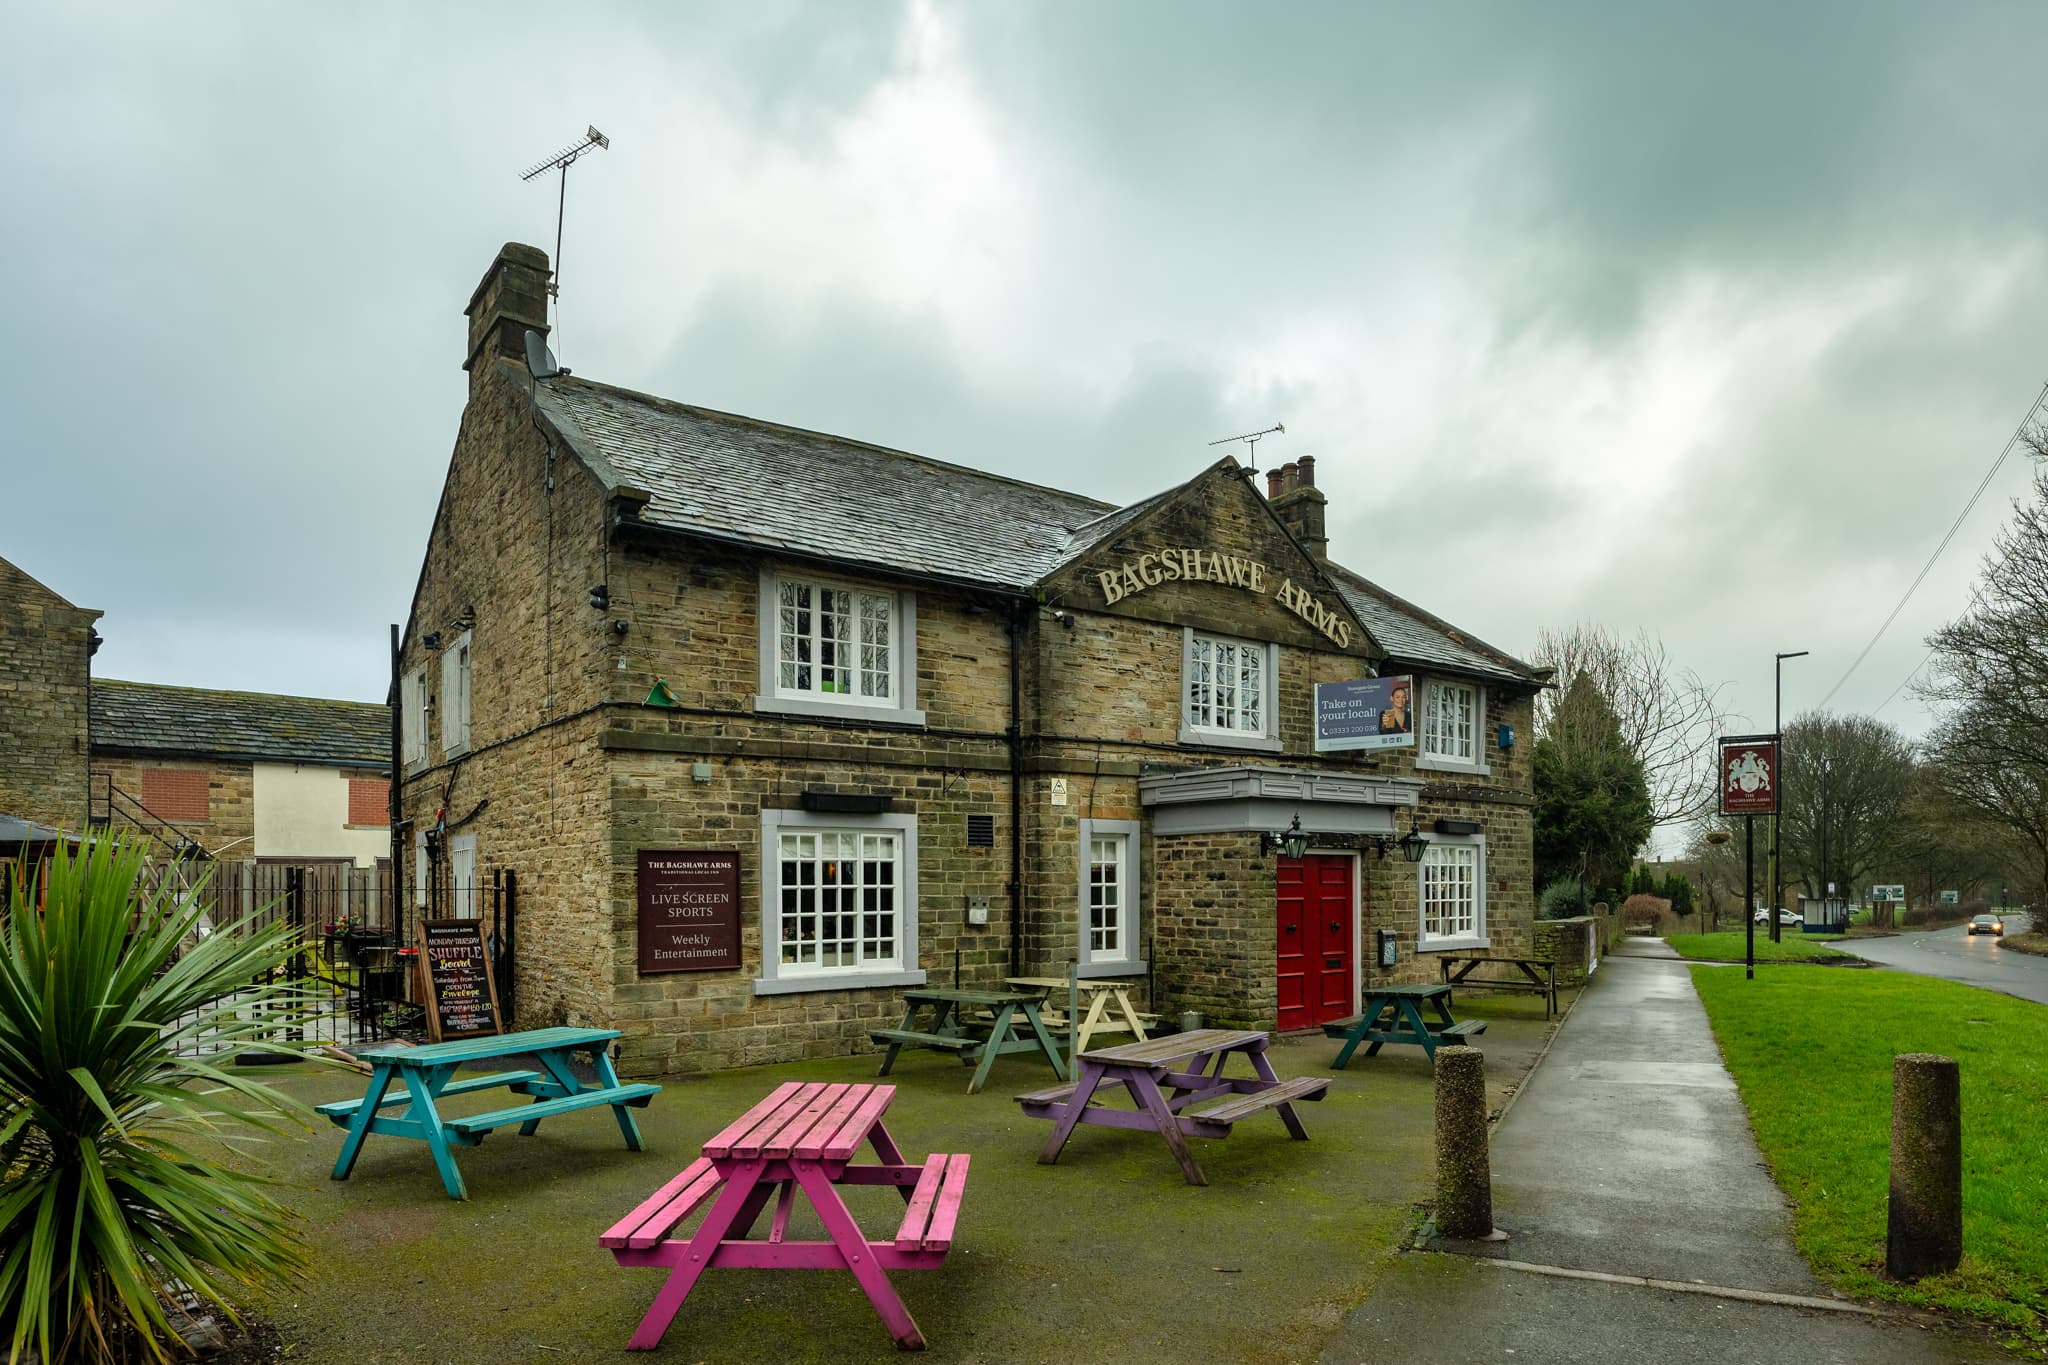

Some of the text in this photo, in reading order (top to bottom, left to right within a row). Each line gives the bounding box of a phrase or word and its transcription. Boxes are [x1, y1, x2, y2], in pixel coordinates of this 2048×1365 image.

[1097, 549, 1352, 649] BAGSHAWE ARMS
[1322, 699, 1362, 709] Take on
[1322, 707, 1376, 722] your local!
[648, 861, 664, 869] THE
[666, 861, 709, 869] BAGSHAWE
[651, 894, 729, 904] LIVE SCREEN
[668, 907, 713, 918] SPORTS
[672, 934, 710, 946] Weekly
[429, 946, 482, 961] SHUFFLE
[655, 948, 727, 959] Entertainment
